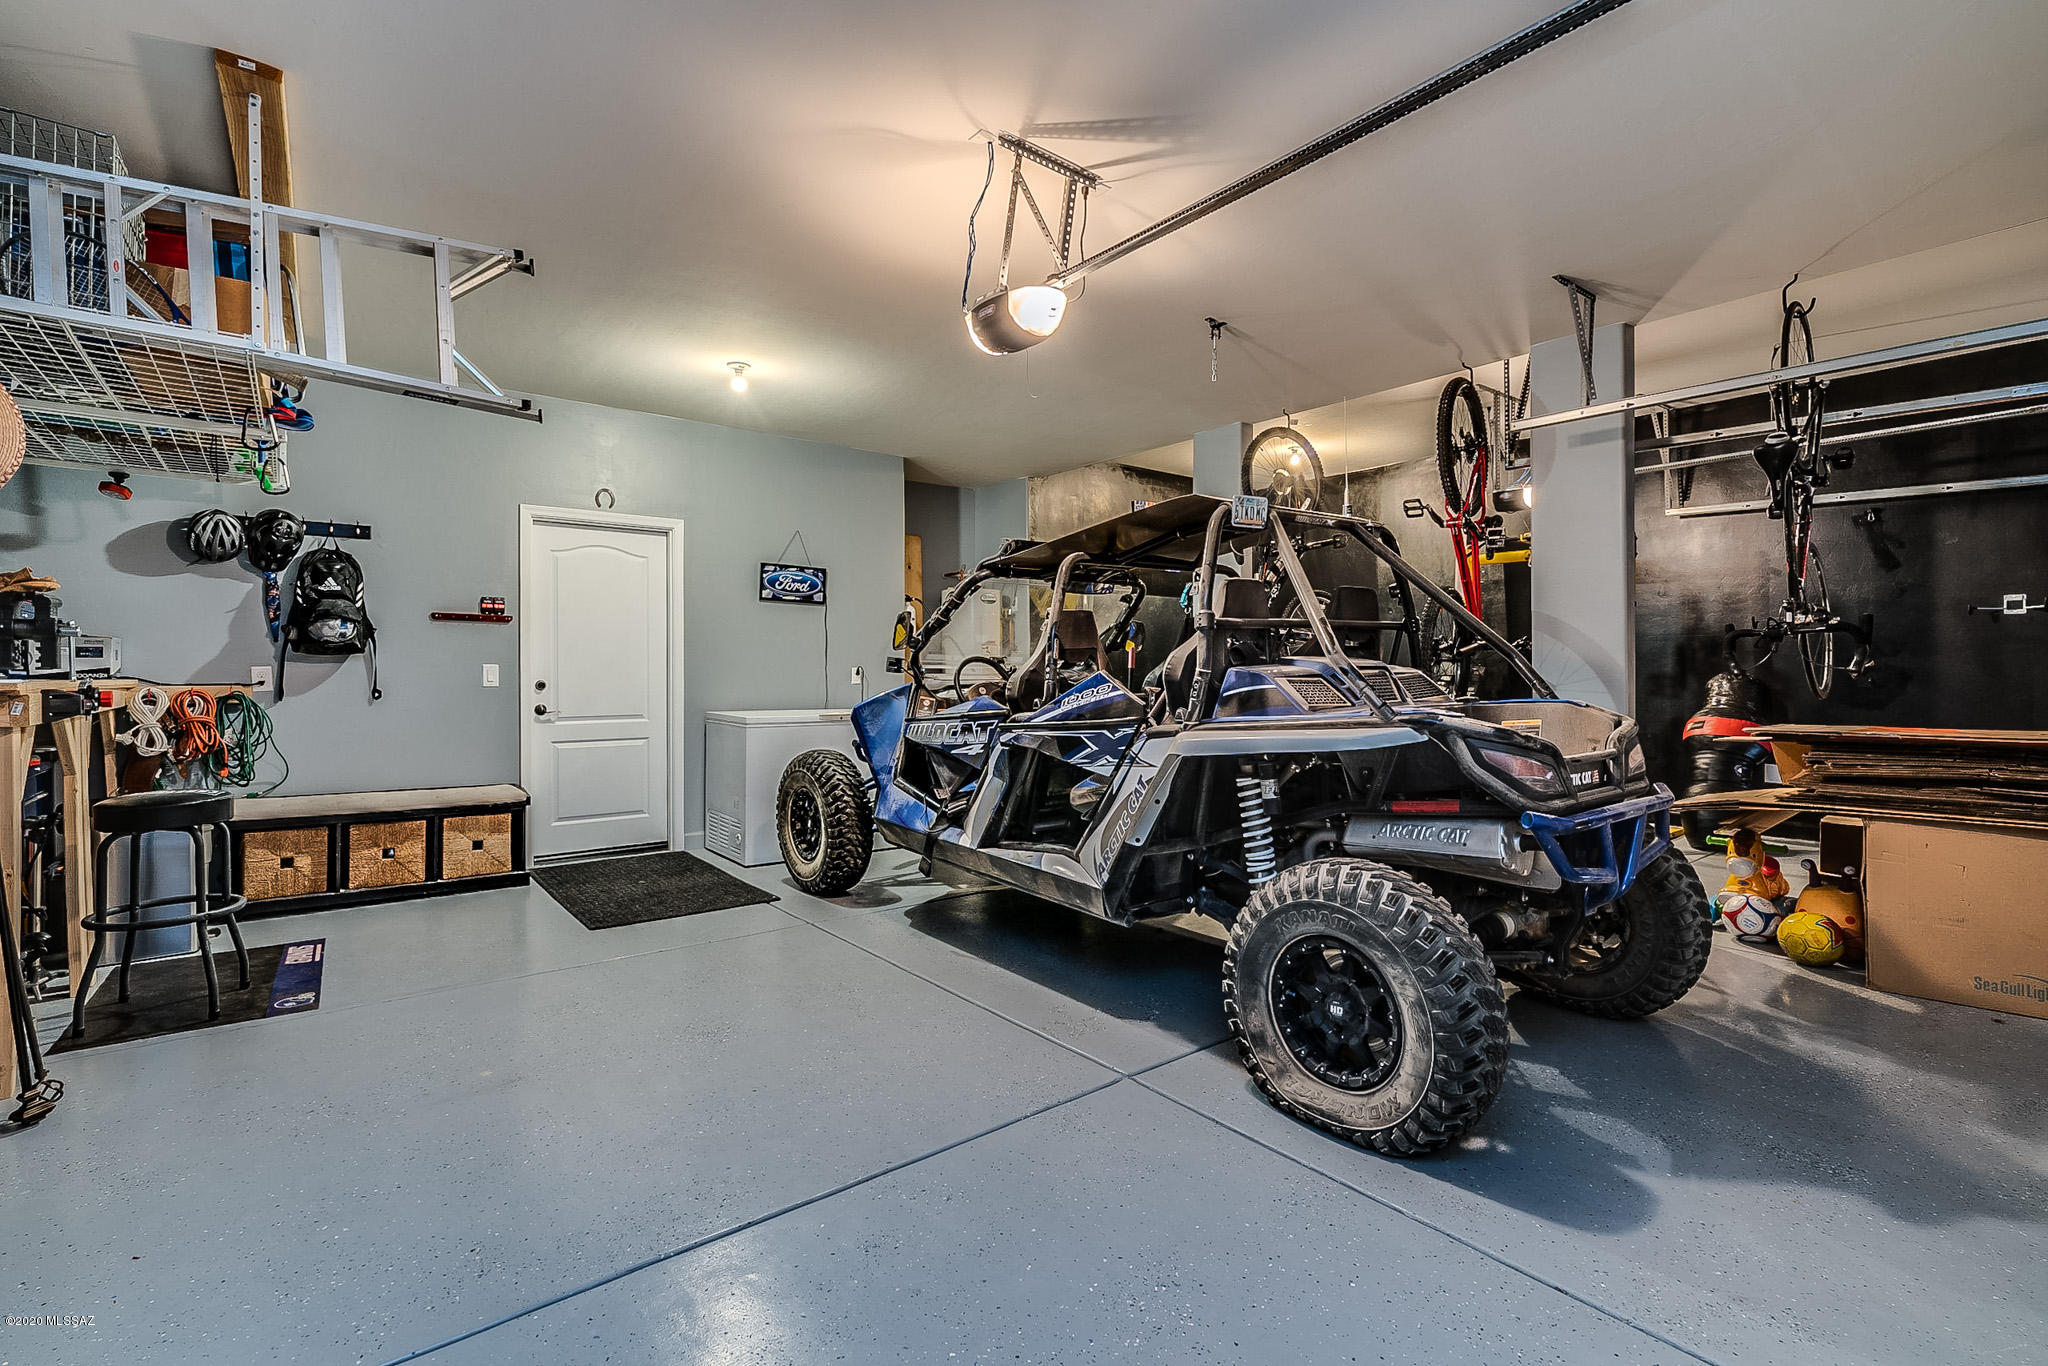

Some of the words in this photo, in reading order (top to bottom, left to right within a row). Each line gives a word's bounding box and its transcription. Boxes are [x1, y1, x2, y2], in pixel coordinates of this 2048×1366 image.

[775, 574, 811, 592] Ford
[1060, 682, 1113, 708] 1000
[905, 720, 999, 745] WILDCAT
[950, 744, 985, 756] 4
[1581, 770, 1592, 785] CAT
[1098, 809, 1132, 888] ARCTIC
[1127, 773, 1149, 815] CAT
[1377, 823, 1436, 841] ARCTIC
[1437, 826, 1471, 845] CAT
[1974, 976, 1999, 992] Sea
[2000, 980, 2025, 997] Gull
